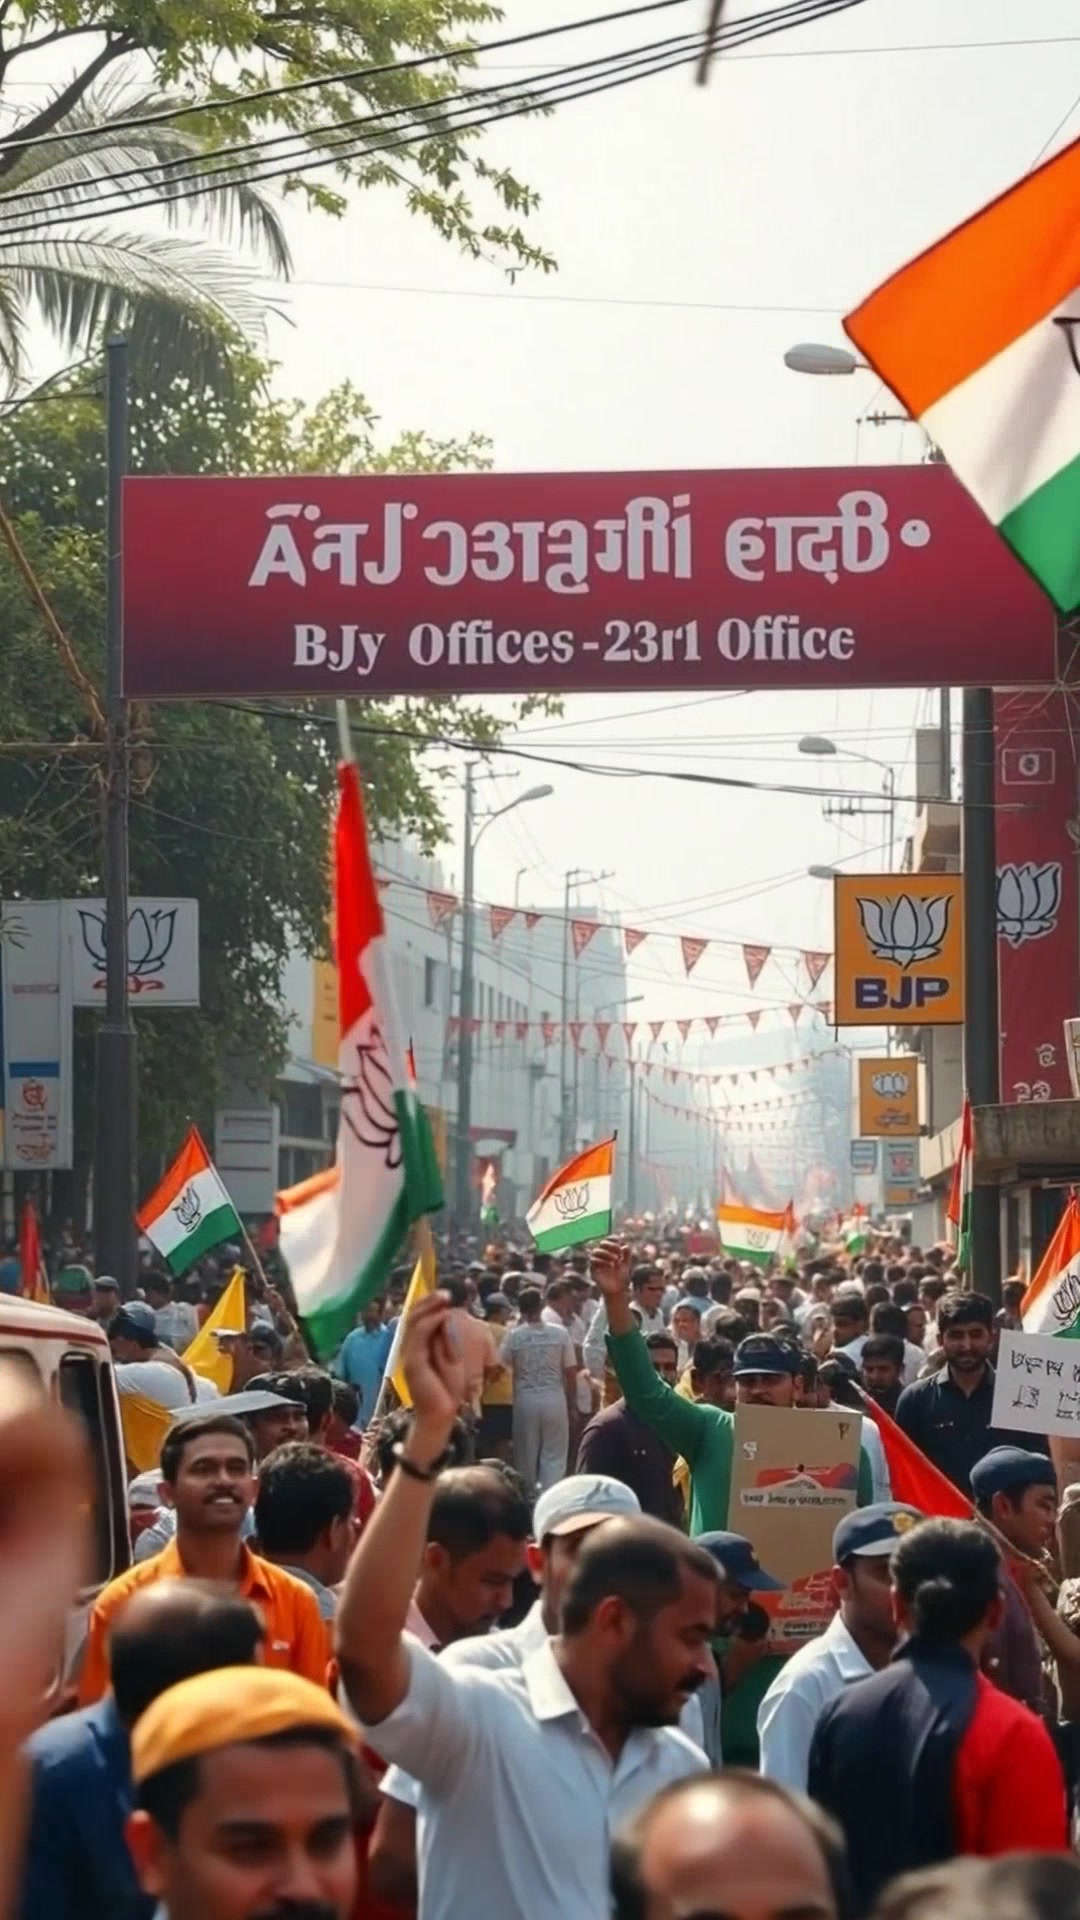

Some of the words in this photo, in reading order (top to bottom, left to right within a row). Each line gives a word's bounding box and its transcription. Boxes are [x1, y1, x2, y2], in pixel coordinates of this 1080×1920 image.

[294, 624, 386, 675] BJy
[717, 615, 854, 661] Office
[855, 976, 949, 1009] BJP
